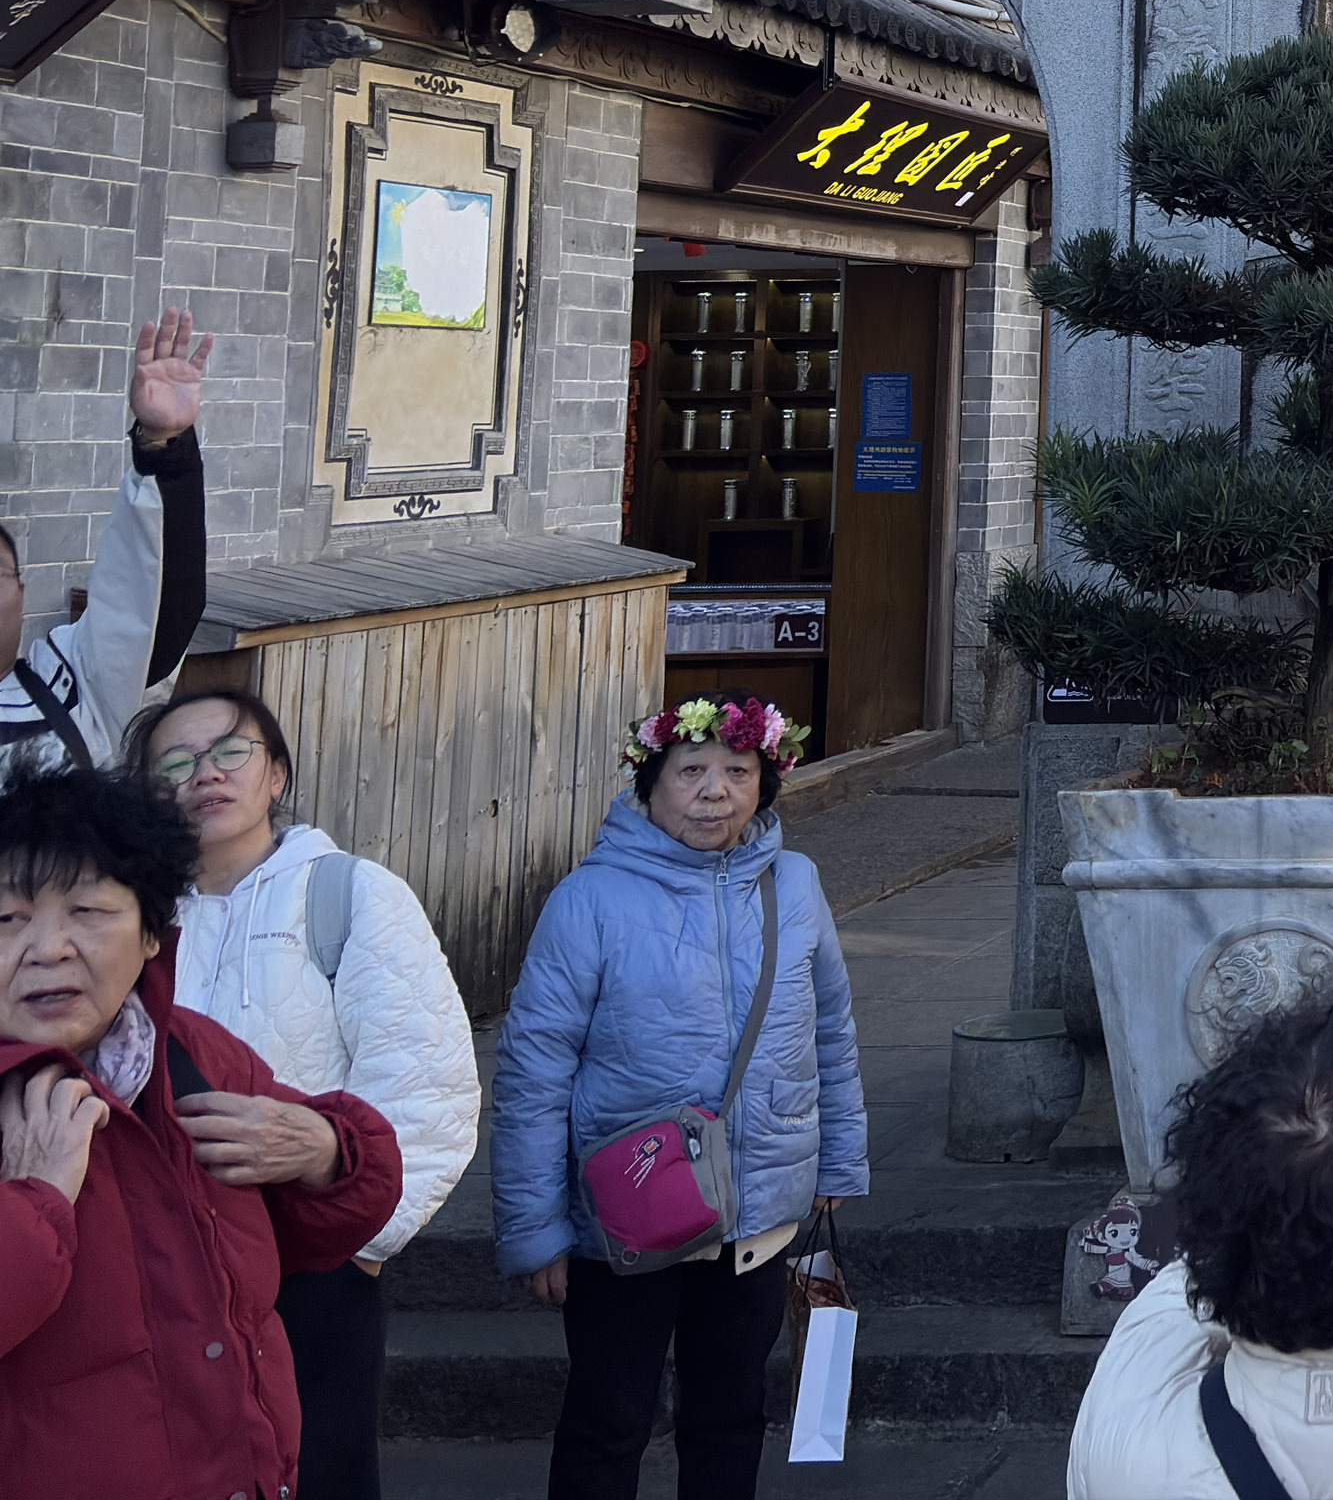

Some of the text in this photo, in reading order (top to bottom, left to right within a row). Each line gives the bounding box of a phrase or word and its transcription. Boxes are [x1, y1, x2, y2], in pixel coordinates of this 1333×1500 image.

[823, 181, 904, 205] DA LI GUO JIANG
[777, 620, 819, 642] A-3
